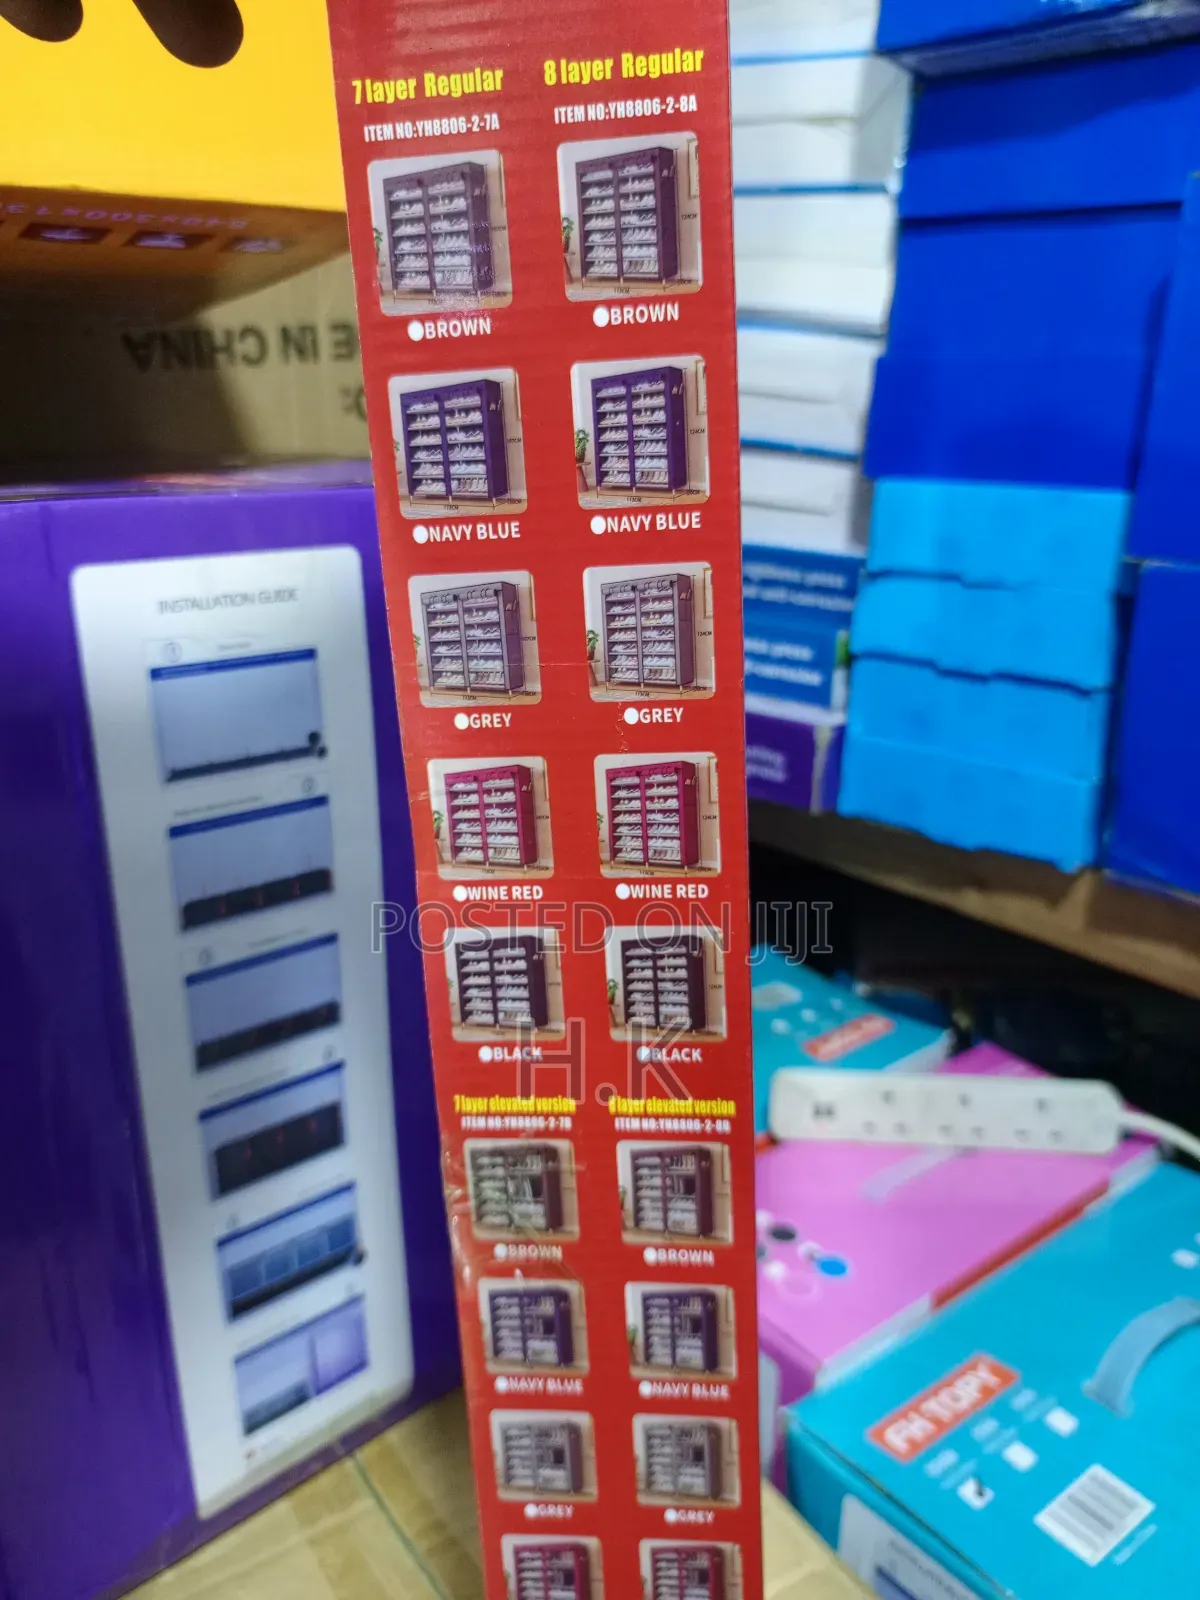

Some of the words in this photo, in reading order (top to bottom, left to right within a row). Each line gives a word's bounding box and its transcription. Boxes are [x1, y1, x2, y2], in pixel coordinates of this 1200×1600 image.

[544, 60, 557, 86] 8
[560, 58, 614, 85] layer
[621, 48, 704, 79] Regular
[352, 80, 362, 105] 7
[365, 78, 417, 104] layer
[424, 68, 504, 98] Regular
[554, 105, 585, 125] ITEM
[364, 122, 394, 143] ITEM
[610, 303, 680, 326] BROWN
[424, 317, 492, 340] BROWN
[121, 324, 270, 372] CHINA
[429, 525, 473, 543] NAVY
[476, 522, 521, 540] BLUE
[607, 515, 652, 533] NAVY
[656, 512, 702, 531] BLUE
[157, 591, 256, 615] INSTALLATION
[258, 588, 300, 605] GUIDE
[469, 713, 512, 729] GREY
[639, 707, 684, 724] GREY
[466, 886, 509, 901] WINE
[511, 885, 544, 900] RED
[630, 883, 673, 899] WINE
[676, 883, 709, 899] RED
[493, 1046, 544, 1062] BLACK
[650, 1047, 703, 1062] BLACK
[694, 1097, 737, 1118] version
[507, 1244, 563, 1260] BROWN
[657, 1248, 715, 1266] BROWN
[507, 1377, 544, 1392] NAVY
[546, 1378, 584, 1395] BLUE
[652, 1382, 689, 1397] NAVY
[691, 1383, 730, 1399] BLUE
